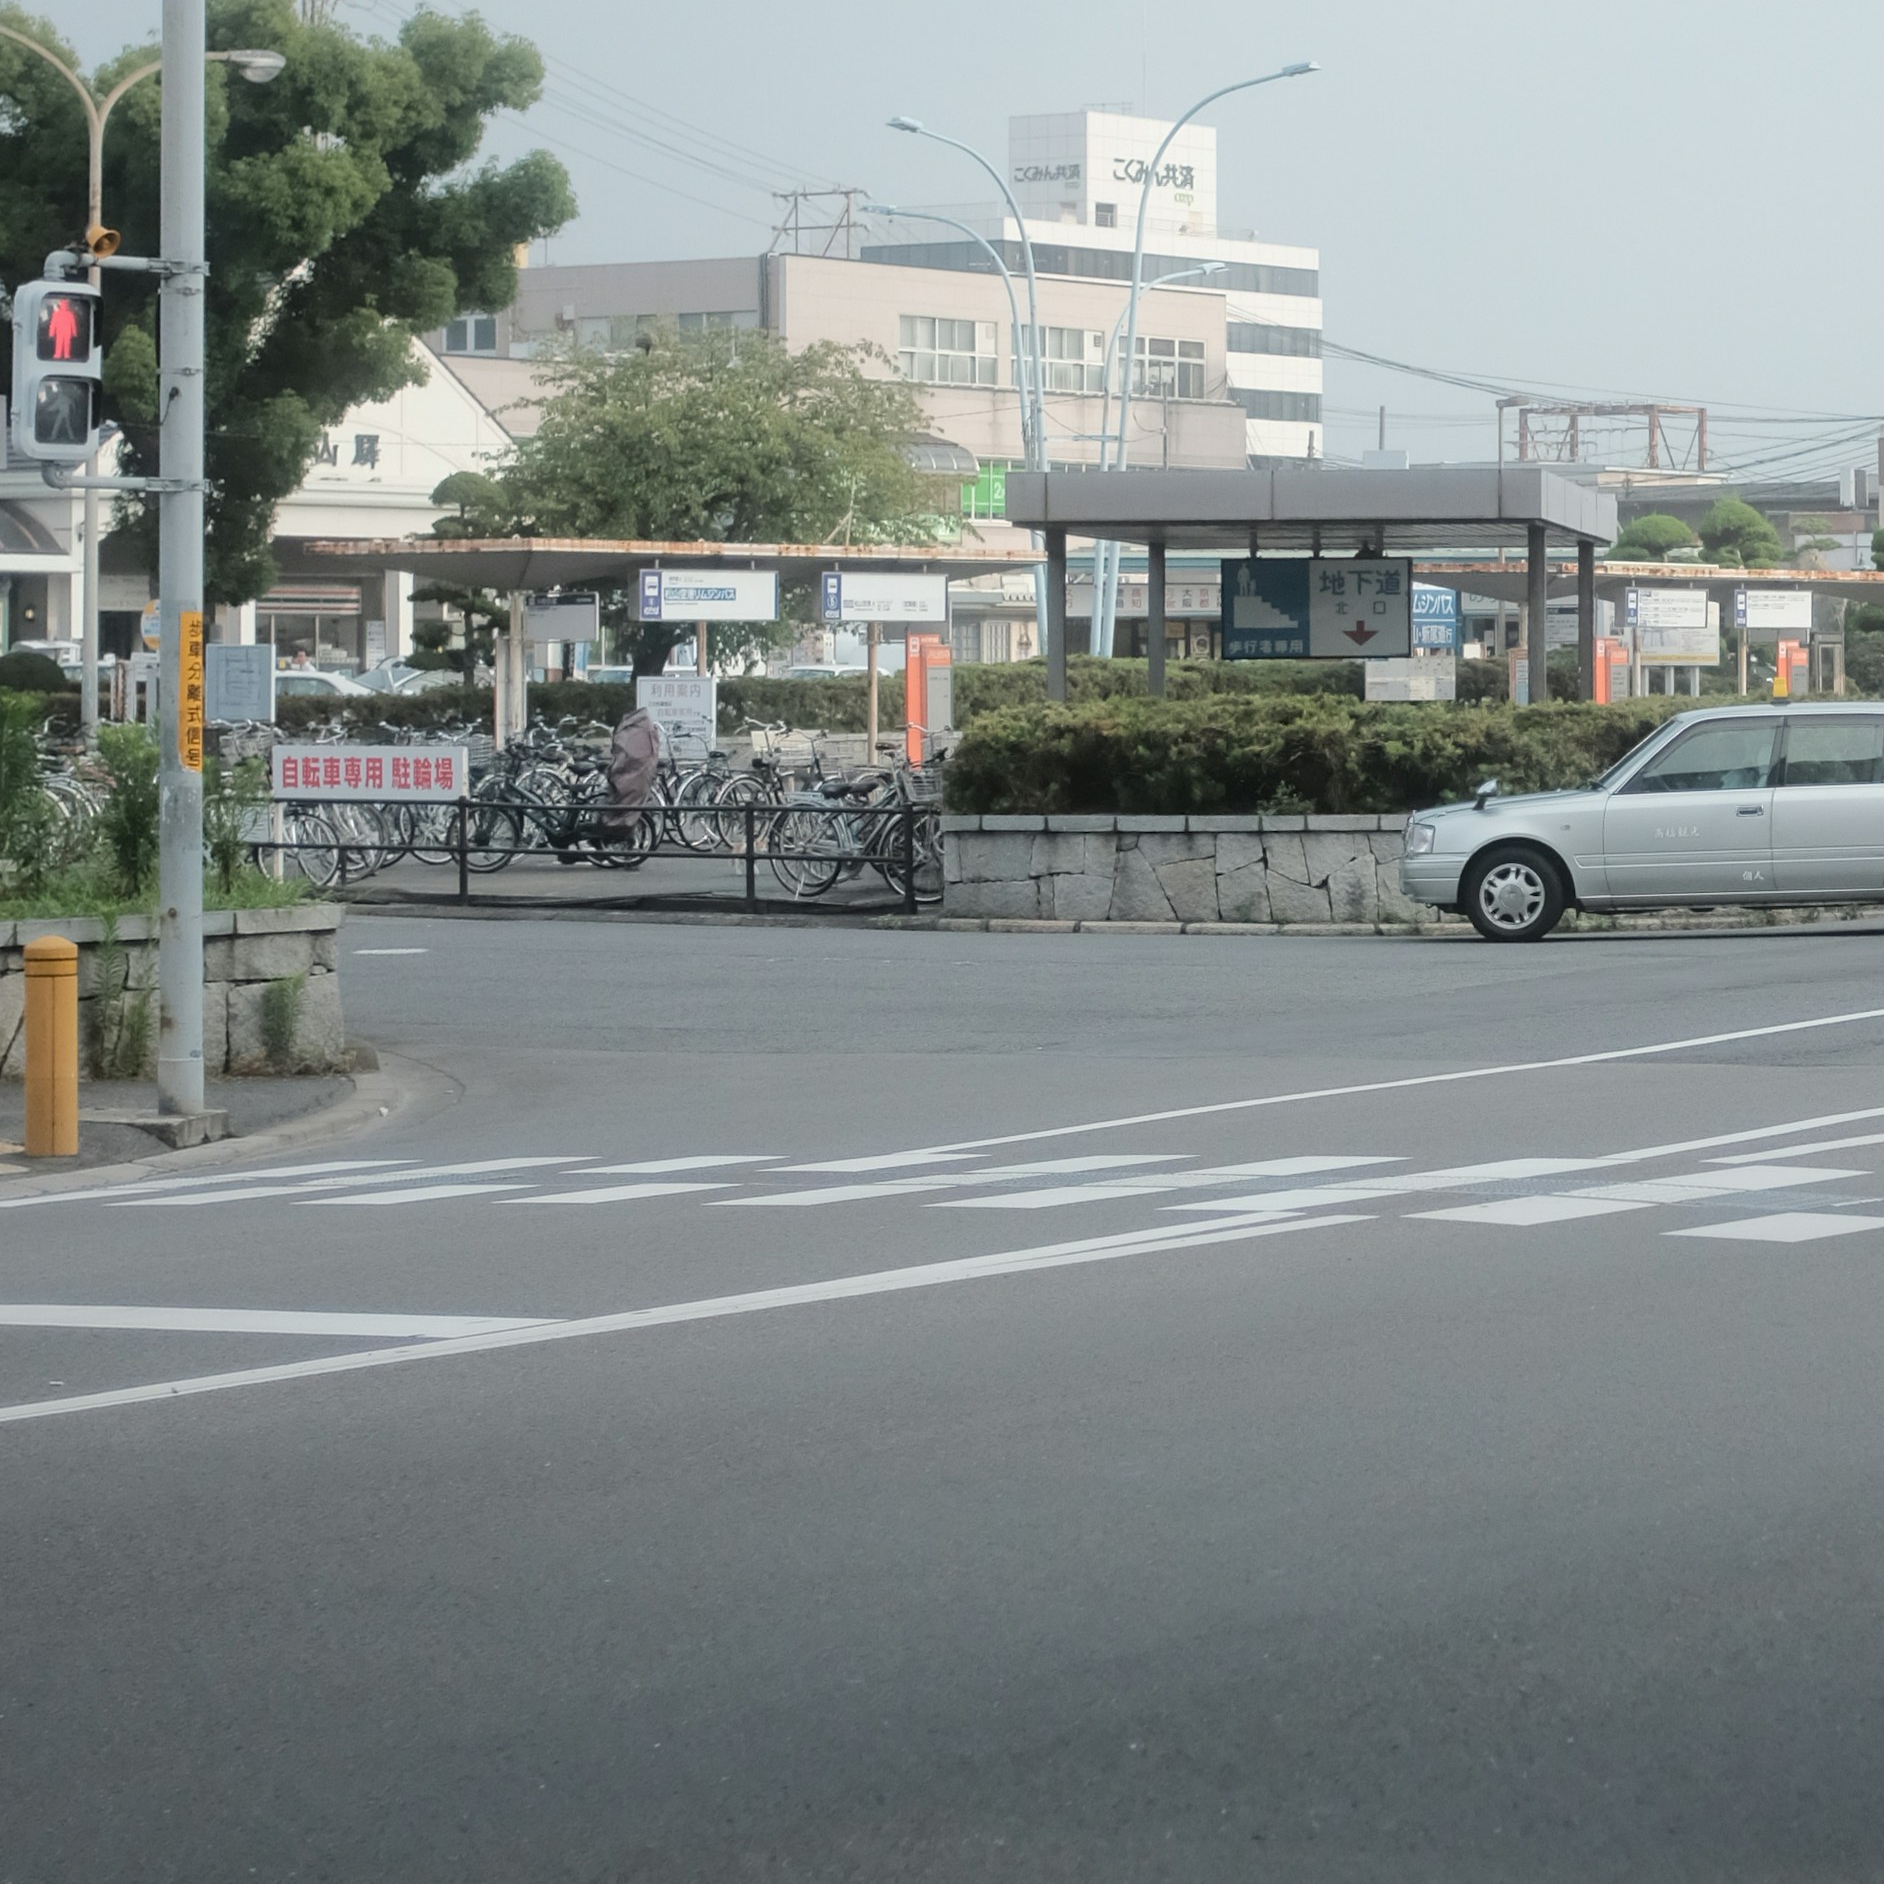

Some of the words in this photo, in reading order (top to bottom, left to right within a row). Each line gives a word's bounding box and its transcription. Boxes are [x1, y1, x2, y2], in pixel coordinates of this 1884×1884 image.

[1318, 569, 1402, 596] 地下道
[1228, 639, 1304, 655] 歩行者専用
[186, 619, 202, 768] 歩車分離式信号
[650, 682, 701, 698] 利用案内
[281, 756, 384, 789] 自転車専用
[391, 756, 454, 790] 駐輪場
[1742, 870, 1765, 882] 個人
